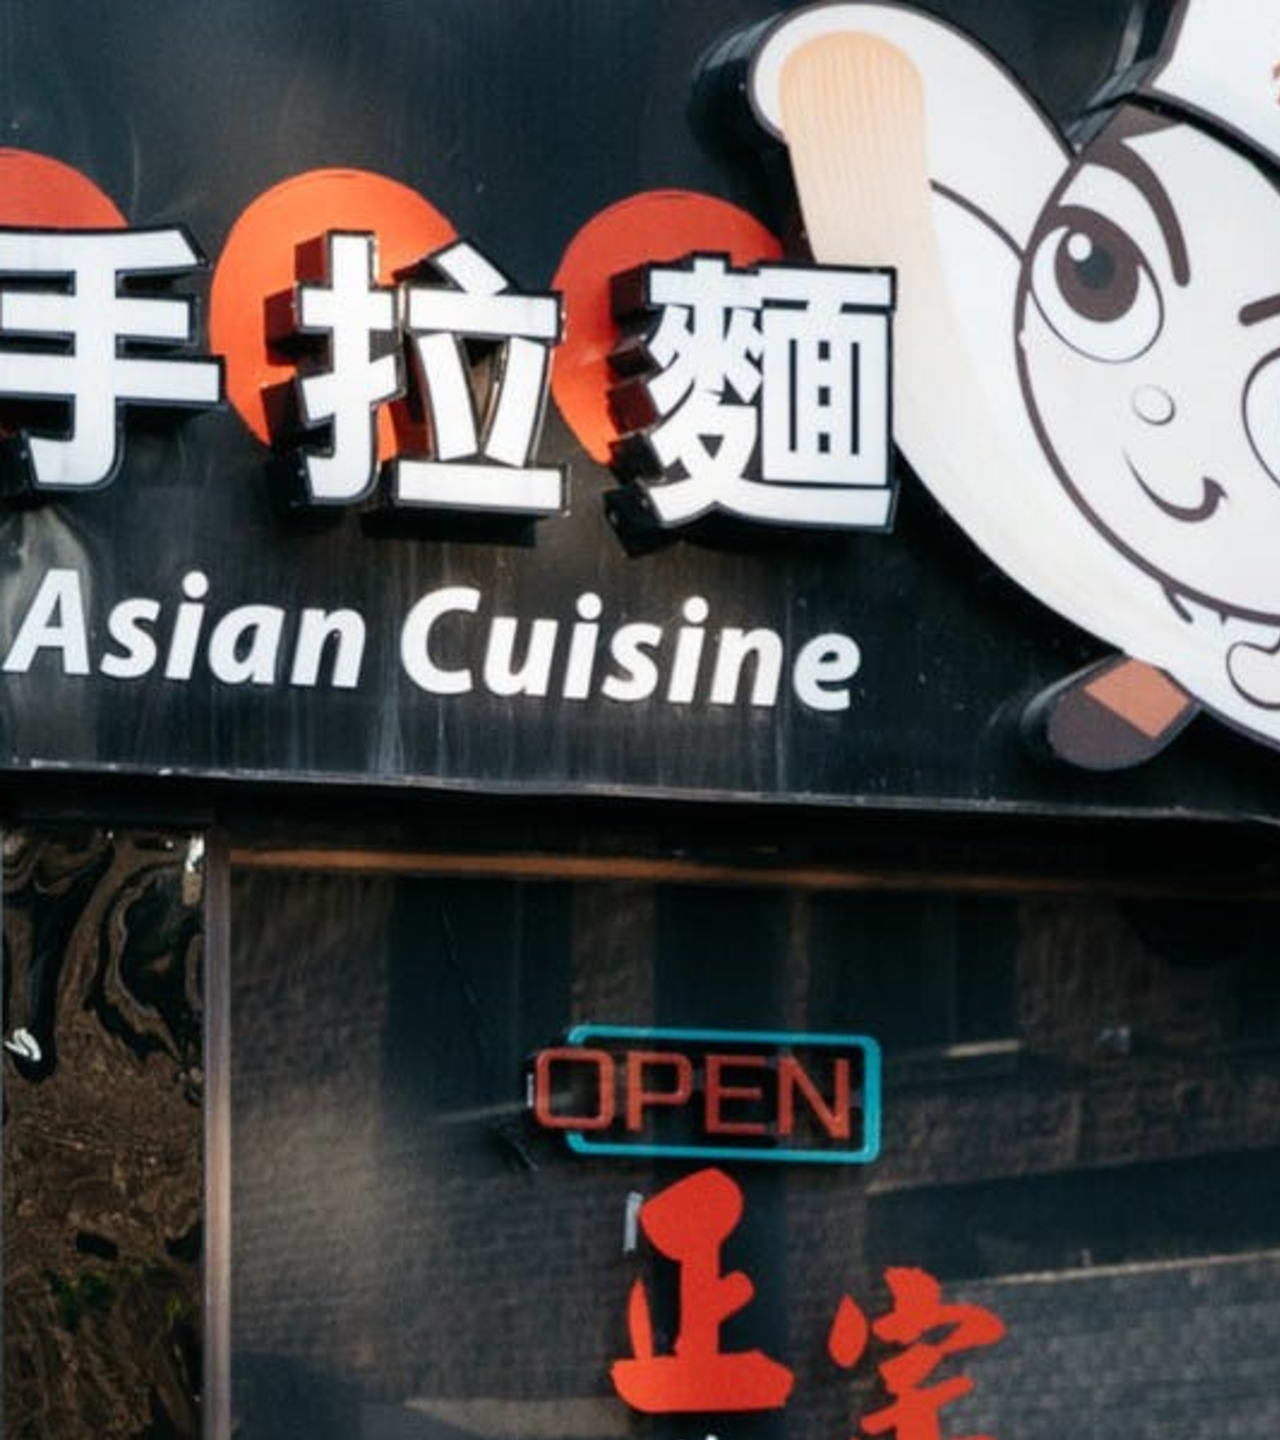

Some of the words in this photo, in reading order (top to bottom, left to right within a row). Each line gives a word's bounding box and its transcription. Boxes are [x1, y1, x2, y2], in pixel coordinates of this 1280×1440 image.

[0, 227, 896, 530] 手拉麵
[2, 568, 367, 690] Asian
[401, 587, 862, 712] Cuisine
[535, 1046, 852, 1140] OPEN
